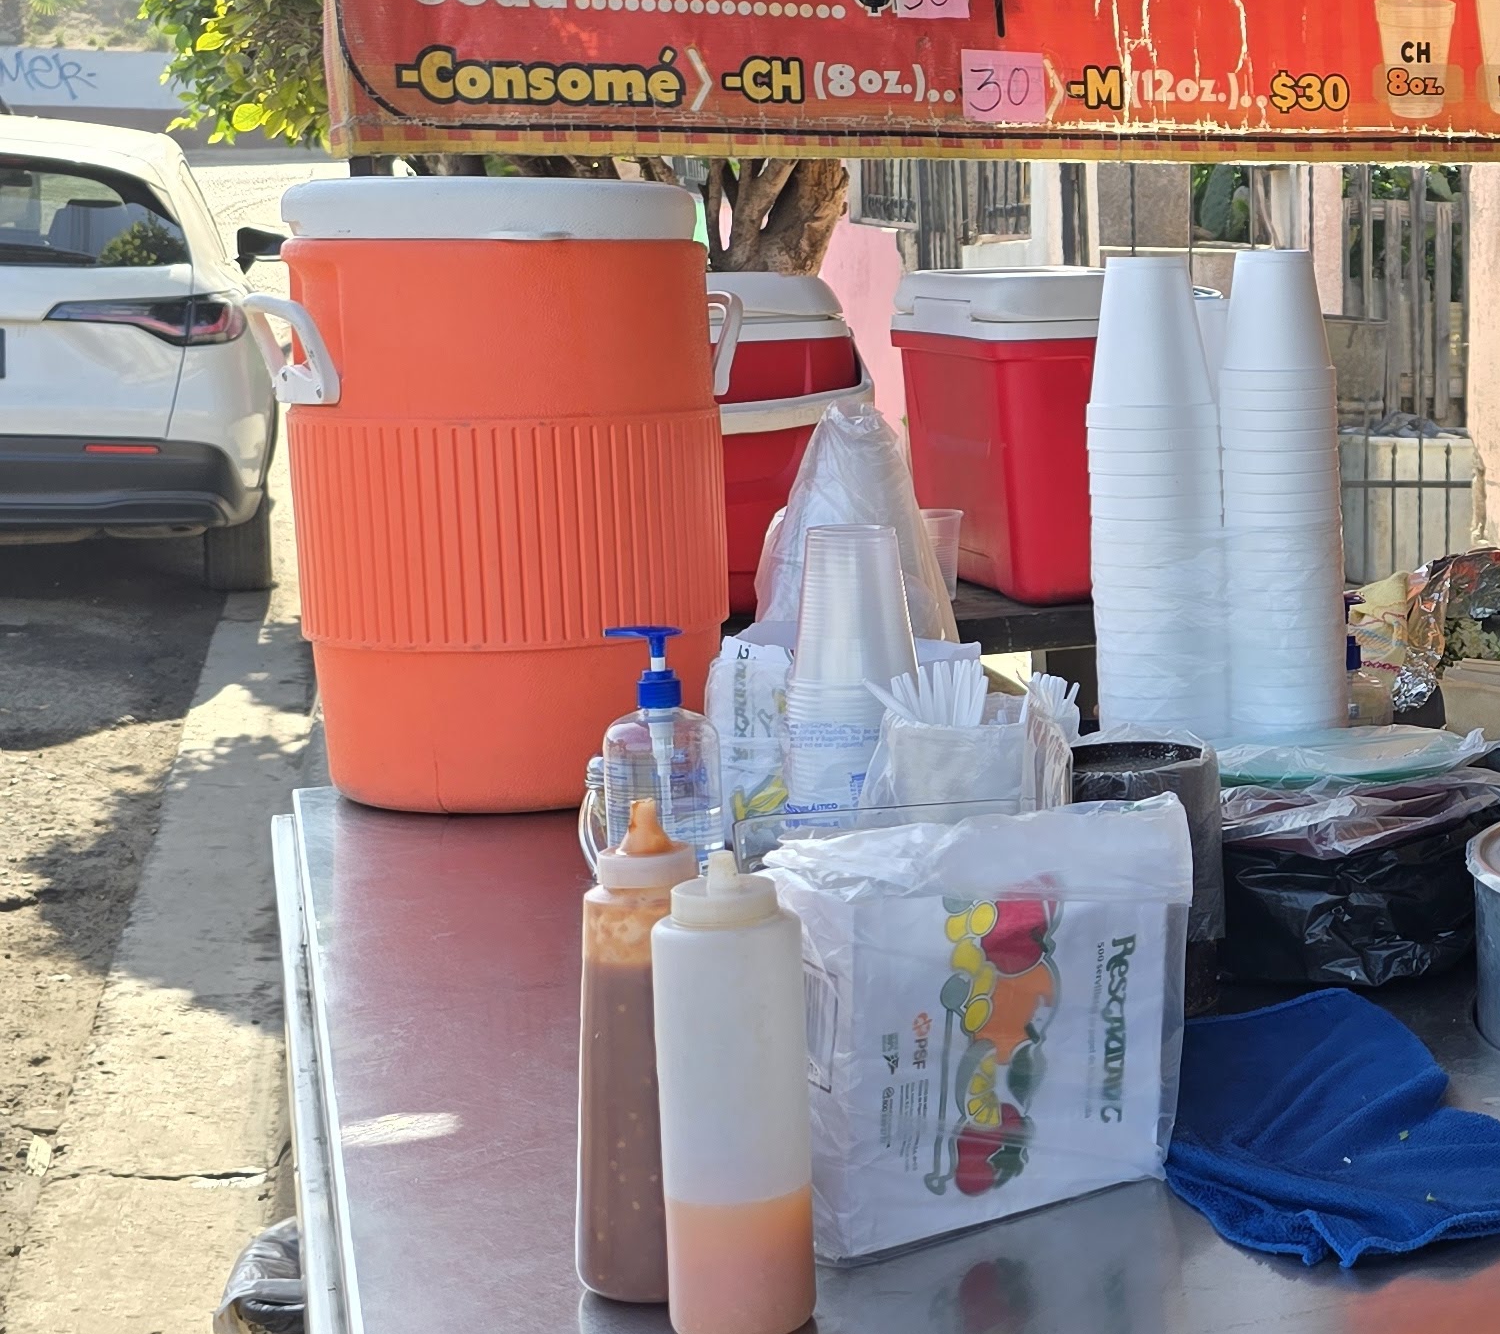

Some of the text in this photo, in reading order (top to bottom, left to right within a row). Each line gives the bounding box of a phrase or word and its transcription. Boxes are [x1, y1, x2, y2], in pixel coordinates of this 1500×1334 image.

[1400, 40, 1432, 64] CH
[968, 69, 1032, 113] 30
[1268, 69, 1352, 113] $30
[1385, 68, 1446, 98] 8oz.
[1096, 941, 1106, 962] 500
[914, 1037, 929, 1070] PSF
